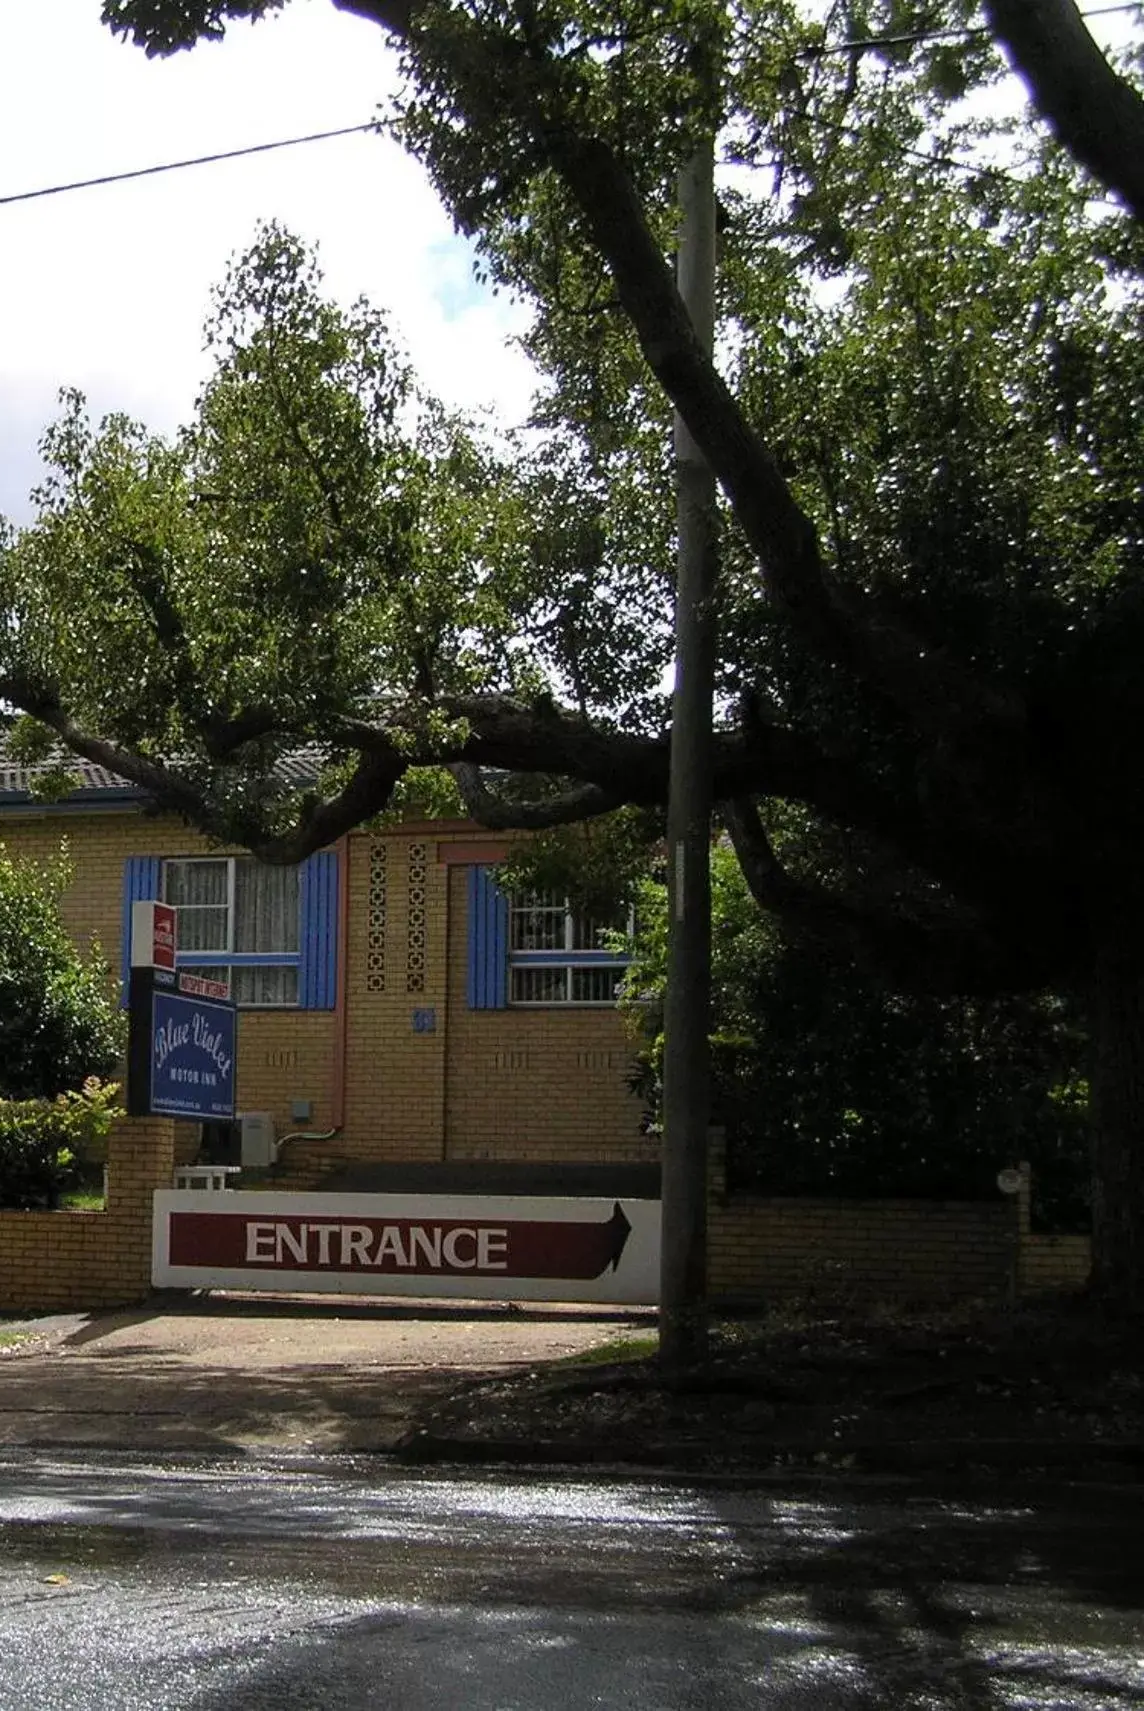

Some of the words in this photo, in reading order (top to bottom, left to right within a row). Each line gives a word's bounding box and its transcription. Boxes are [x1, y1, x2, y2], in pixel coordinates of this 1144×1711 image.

[155, 1017, 190, 1069] Blue
[192, 1012, 231, 1079] Violet
[170, 1067, 199, 1084] MOTOR
[201, 1072, 217, 1087] INN
[245, 1221, 509, 1271] ENTRANCE
